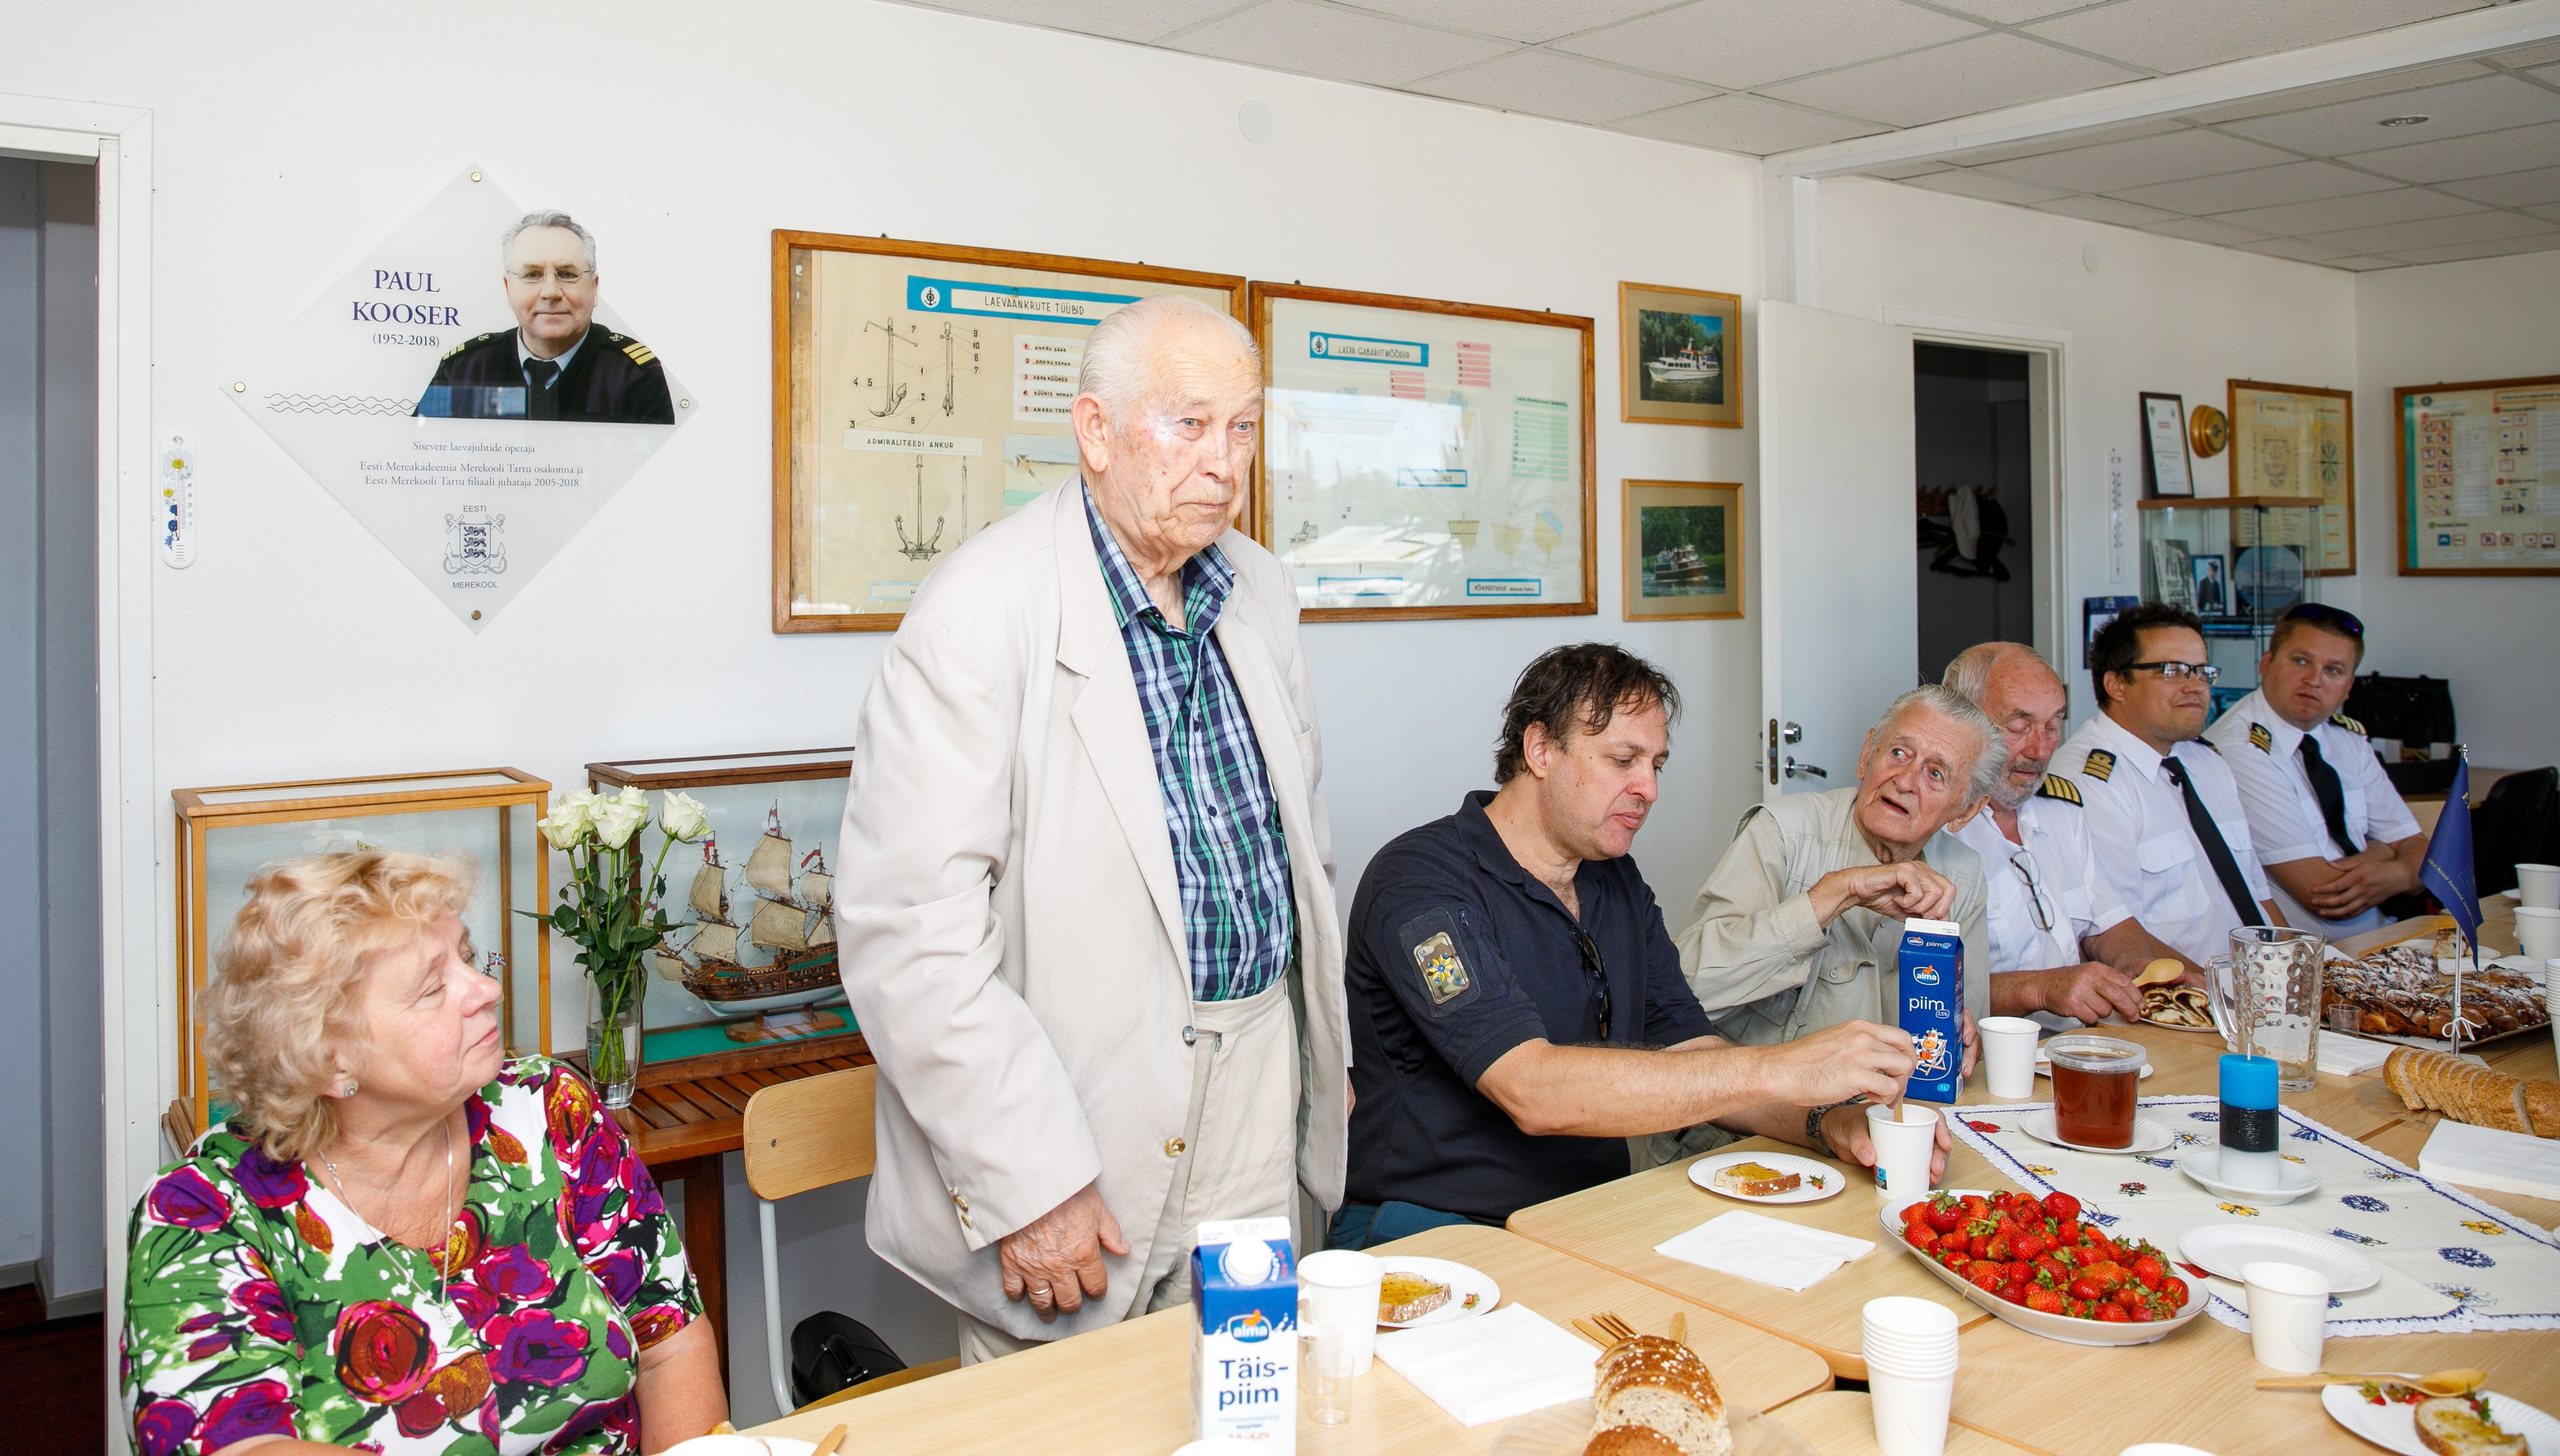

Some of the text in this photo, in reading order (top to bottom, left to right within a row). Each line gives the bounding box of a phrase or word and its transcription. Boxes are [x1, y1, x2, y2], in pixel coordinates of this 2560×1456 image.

[373, 269, 441, 293] PAUL
[983, 295, 1085, 315] LAEVAANKRUTE TÜÜBID
[352, 300, 462, 327] KOOSER
[911, 325, 917, 333] 7
[372, 332, 440, 349] (1952-2018)
[1338, 345, 1356, 355] LAEVA
[412, 440, 448, 451] Sisevete
[450, 441, 503, 454] laevajuhtide
[866, 438, 925, 448] ADMIRALITEEDI
[360, 460, 585, 477] Eesti Mereakadeemia Merekooli Tartu osakonna ja
[365, 475, 580, 488] Eesti Merekooli Tartu filiaali juhataja 2005-2018
[462, 505, 487, 513] EESTI
[452, 581, 499, 590] MEREKOOL
[1916, 971, 1937, 981] alma
[1909, 995, 1945, 1012] piim
[1233, 1323, 1268, 1338] alma
[1218, 1355, 1289, 1380] Täis-
[1218, 1382, 1279, 1412] piim
